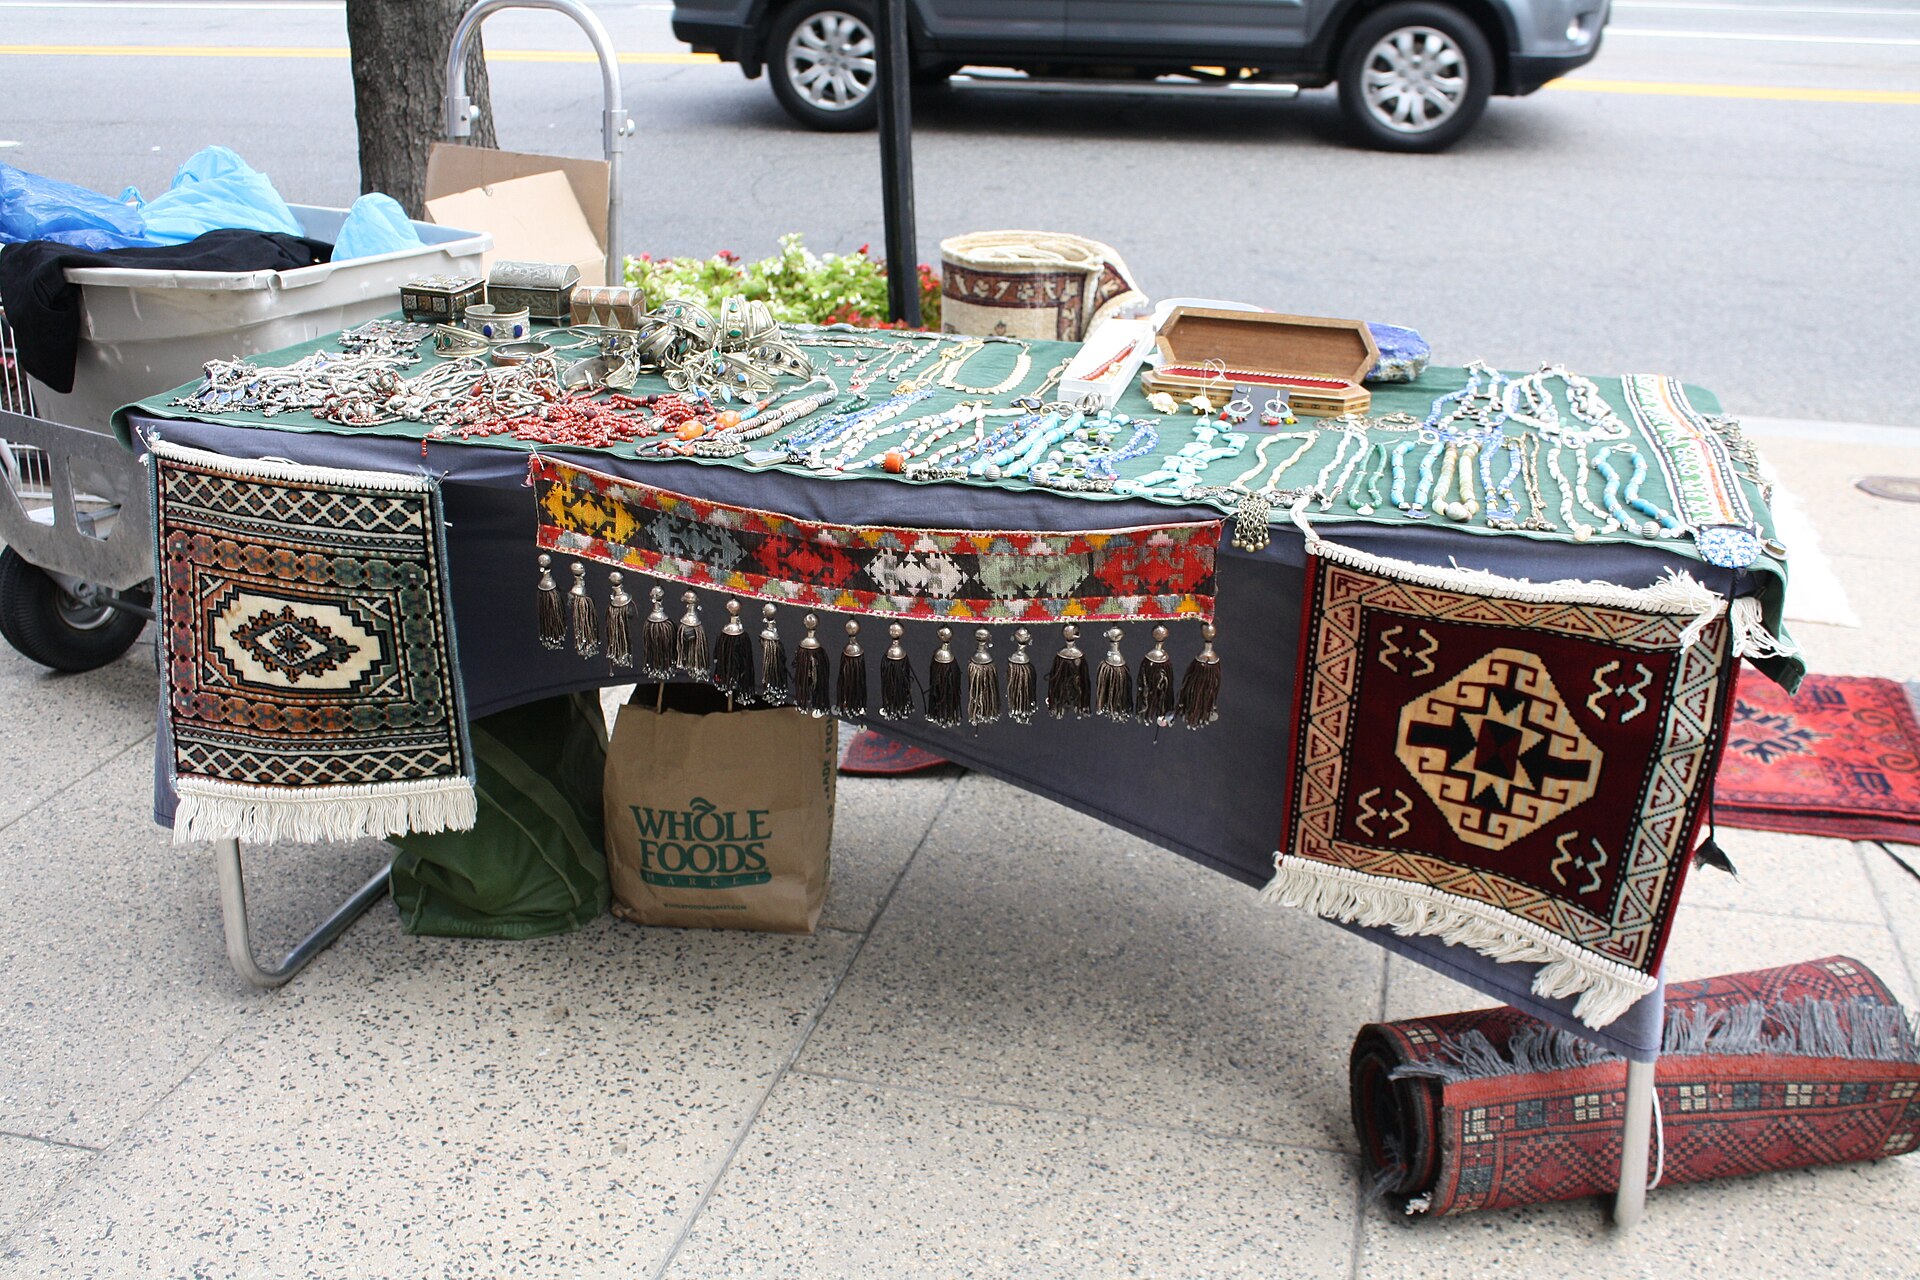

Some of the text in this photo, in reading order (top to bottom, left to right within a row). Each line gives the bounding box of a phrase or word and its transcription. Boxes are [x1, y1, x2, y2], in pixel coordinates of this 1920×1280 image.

[629, 800, 773, 842] WHOLE
[638, 838, 767, 874] FOODS
[646, 873, 760, 886] MARKET
